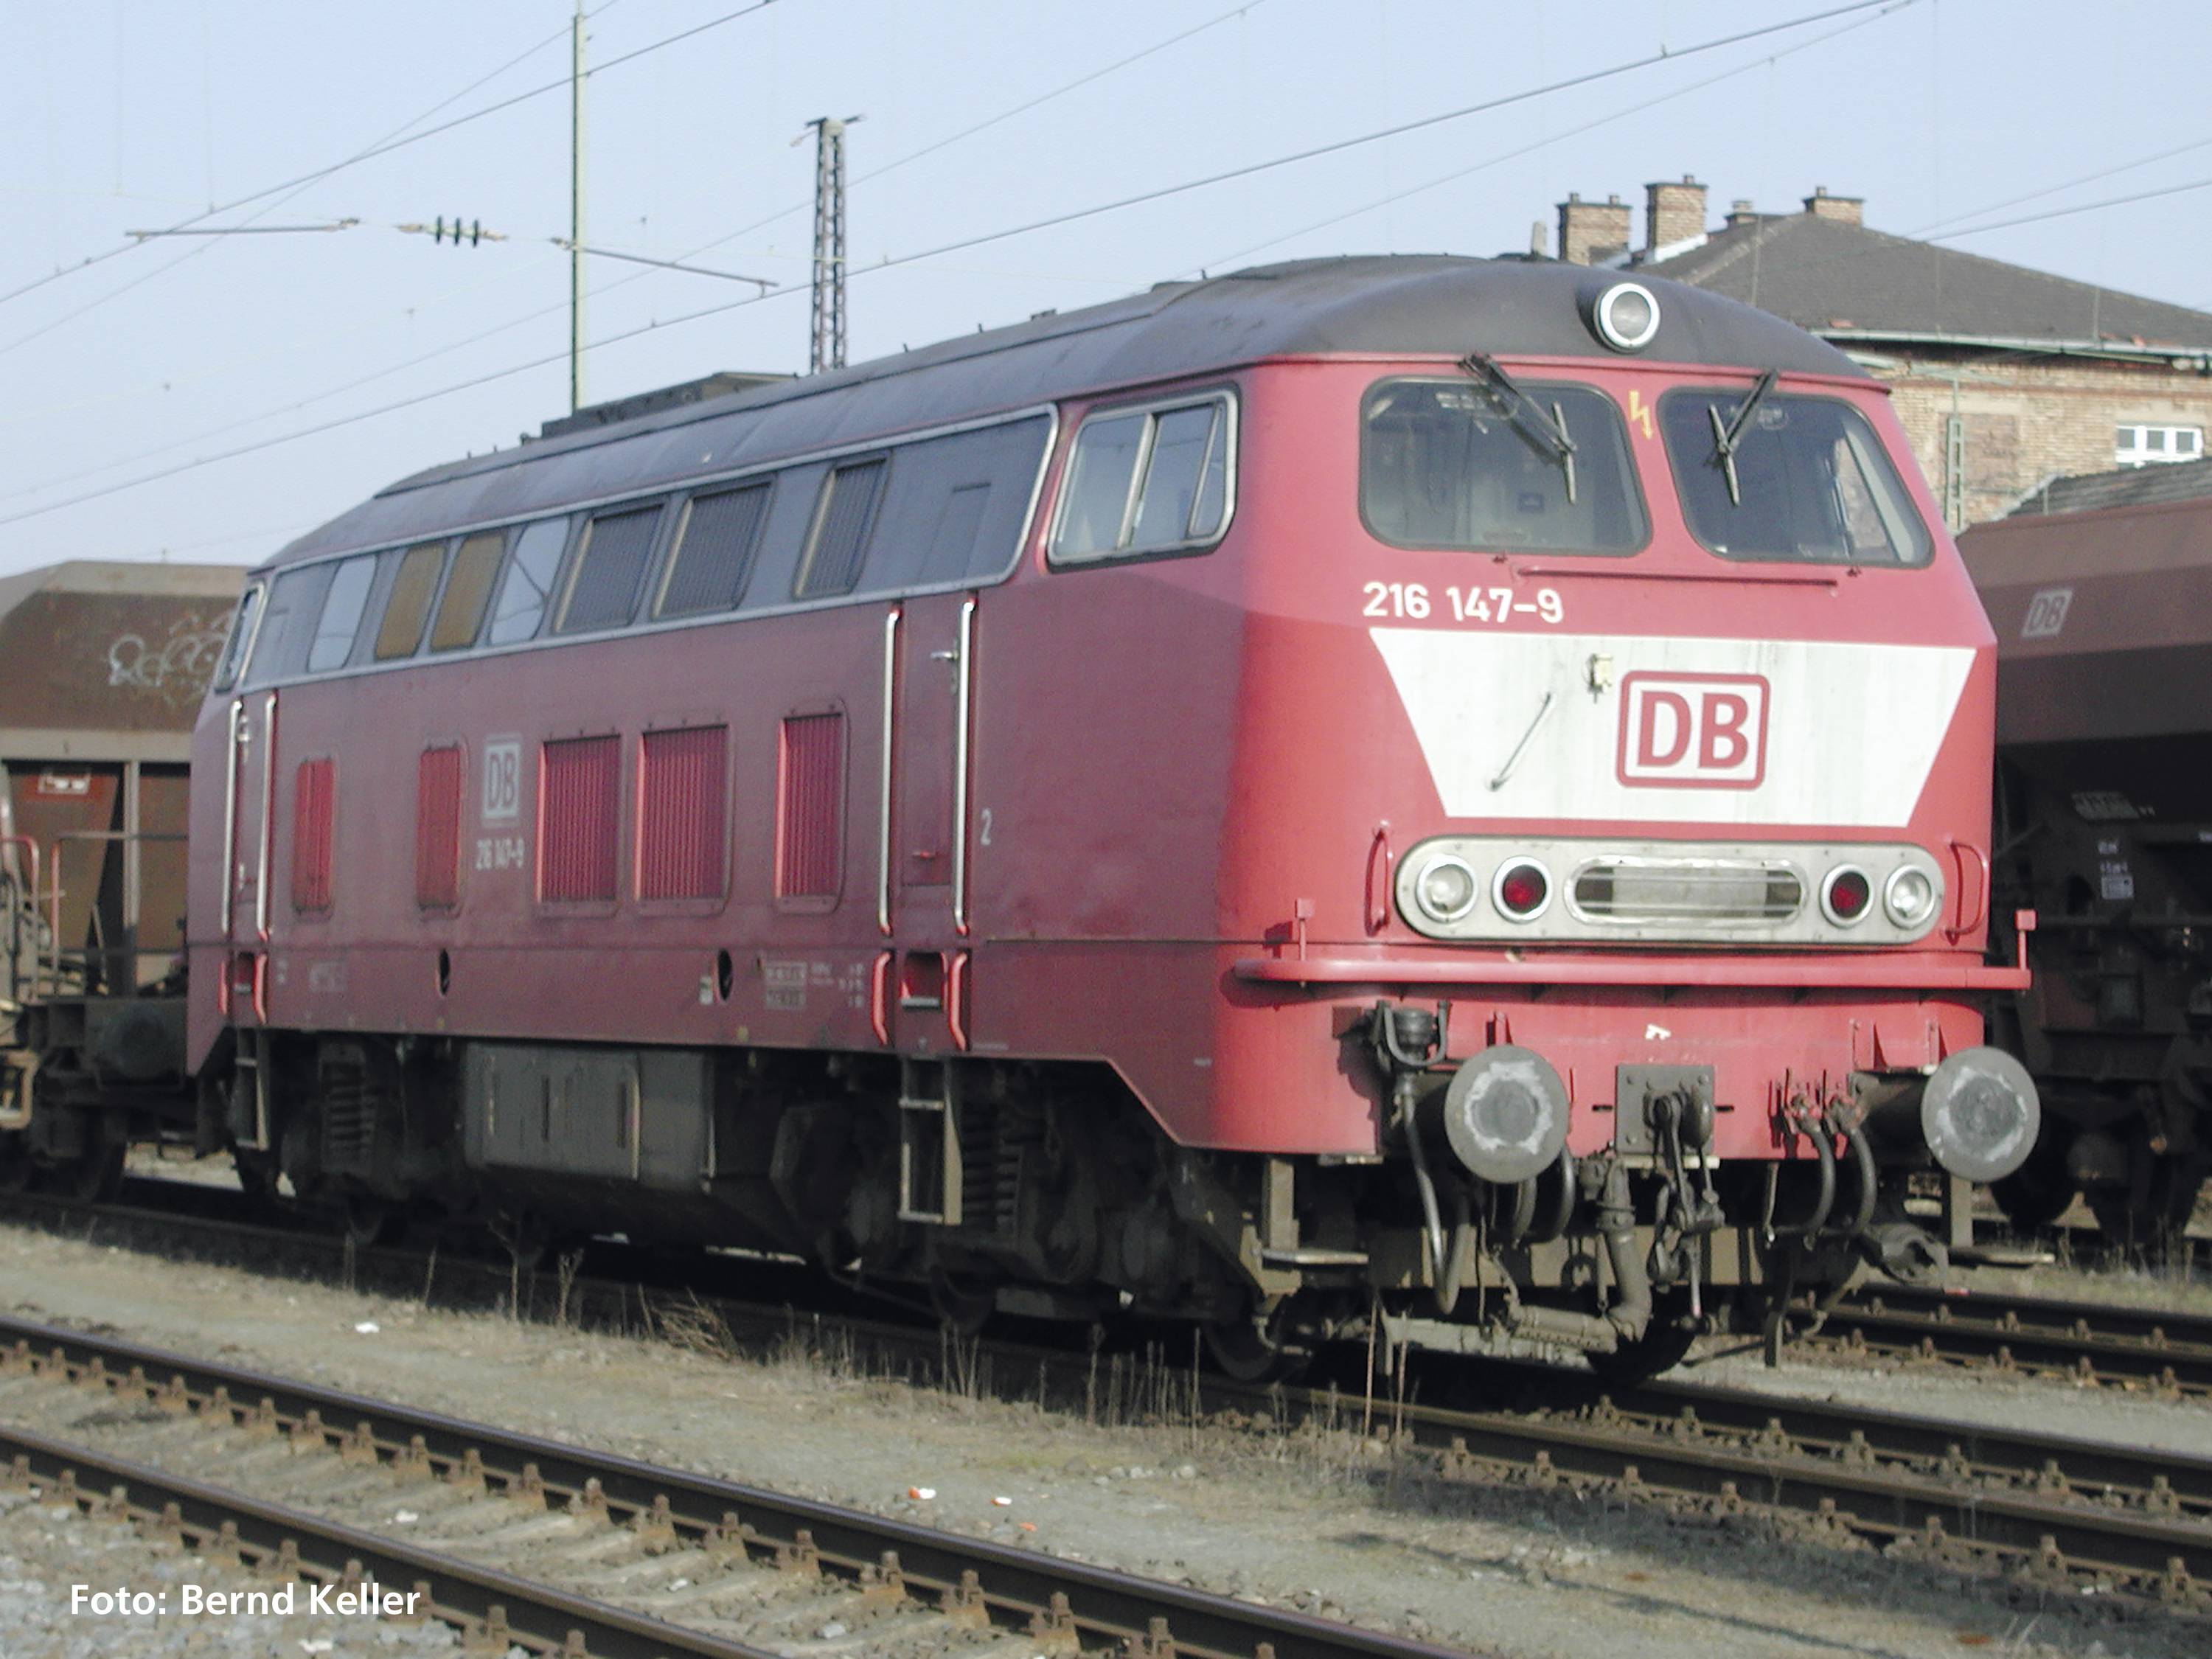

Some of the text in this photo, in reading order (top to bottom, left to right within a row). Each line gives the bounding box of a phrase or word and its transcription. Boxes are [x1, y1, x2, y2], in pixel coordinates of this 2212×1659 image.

[1362, 580, 1564, 624] 216 147-9
[1636, 690, 1750, 770] DB
[487, 749, 515, 811] DB
